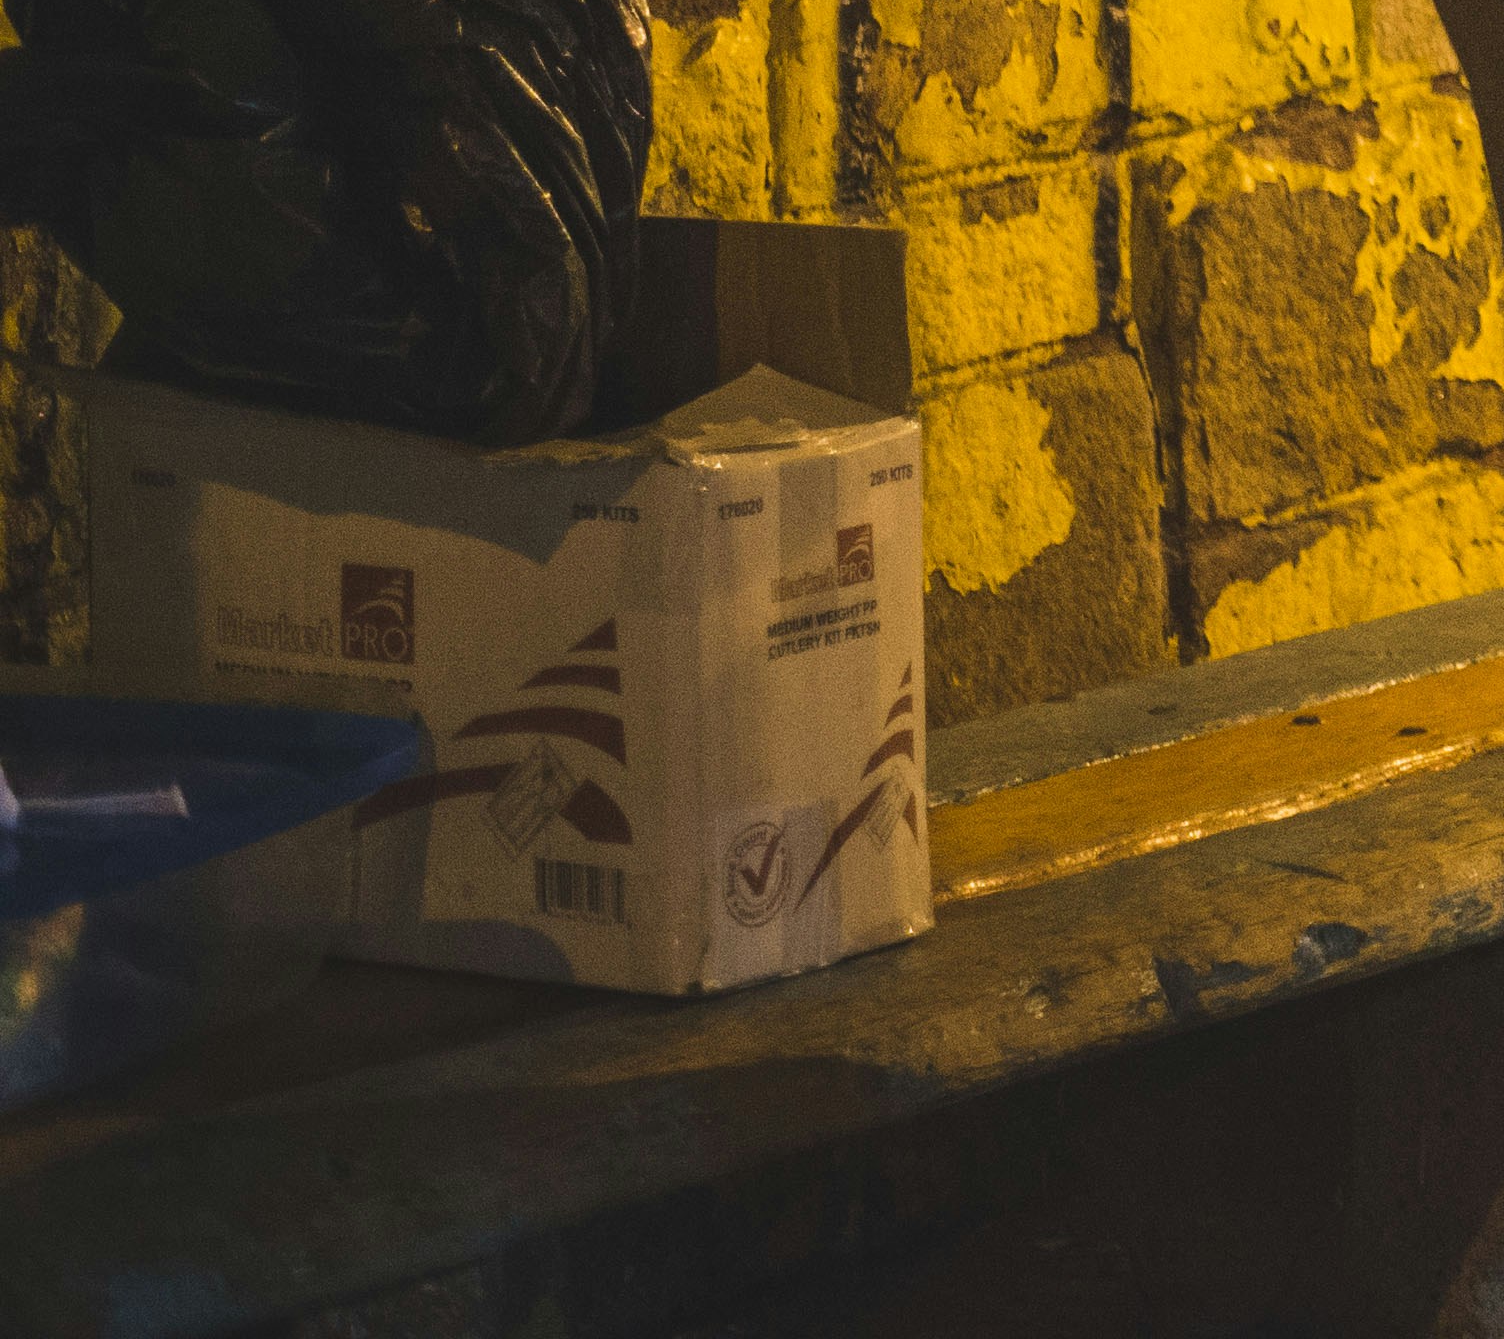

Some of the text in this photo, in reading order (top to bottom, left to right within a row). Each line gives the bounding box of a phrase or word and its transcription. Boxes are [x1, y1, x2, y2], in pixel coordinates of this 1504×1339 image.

[890, 463, 914, 482] KITS
[602, 505, 640, 523] KITS
[839, 559, 873, 585] PRO
[215, 605, 410, 662] Market PRO
[766, 614, 814, 639] MEDIUM
[815, 602, 861, 626] WEIGHT
[767, 635, 821, 661] CUTLERY
[824, 629, 842, 647] KIT
